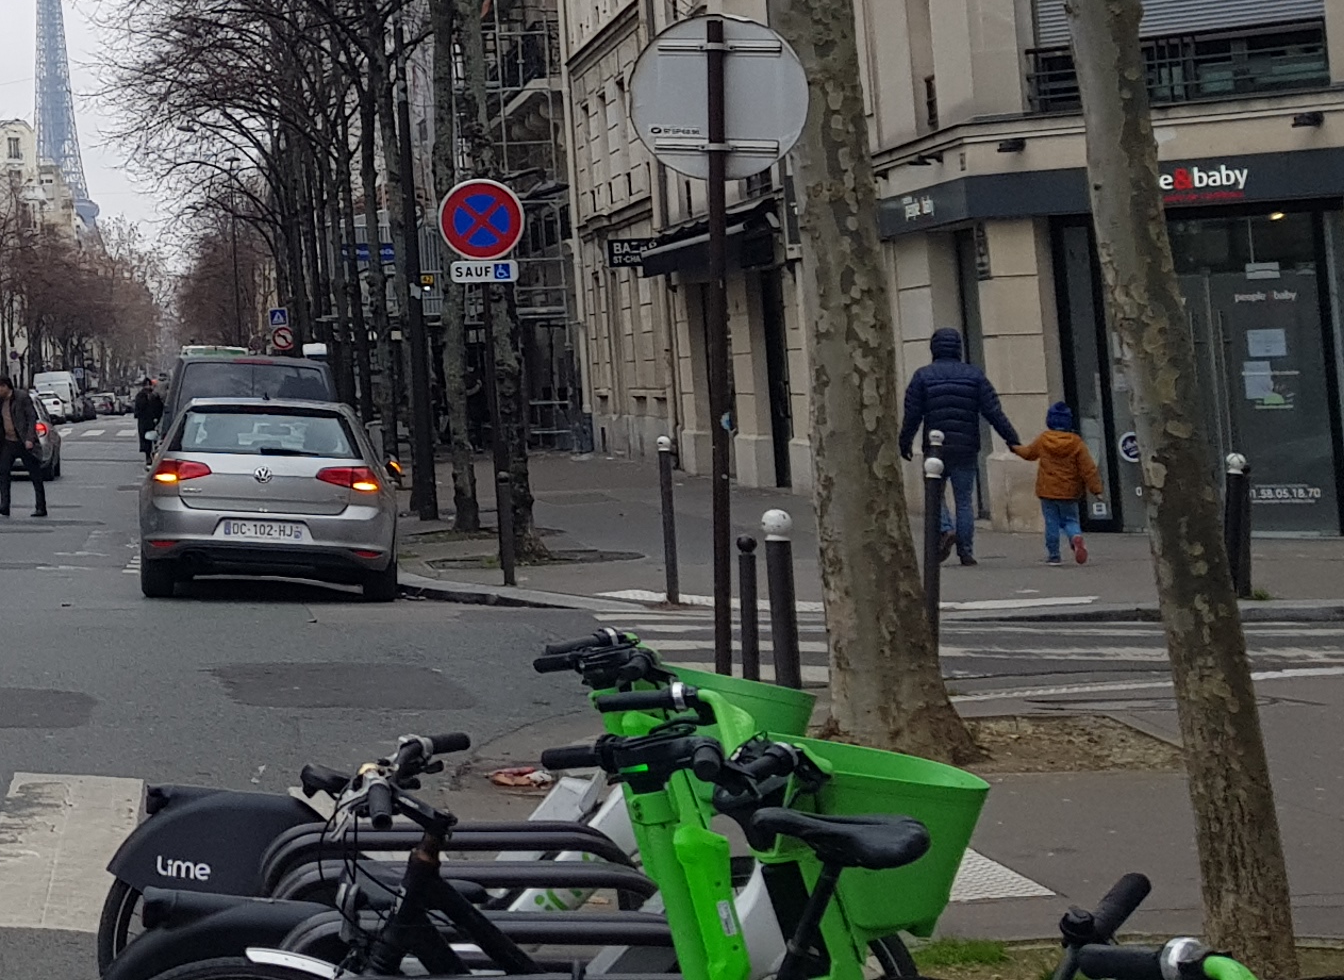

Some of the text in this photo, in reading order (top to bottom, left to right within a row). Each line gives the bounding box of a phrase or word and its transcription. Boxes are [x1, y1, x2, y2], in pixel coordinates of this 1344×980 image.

[454, 266, 492, 278] SAUF
[231, 522, 294, 537] DC-102-HJ
[156, 855, 212, 881] Lime
